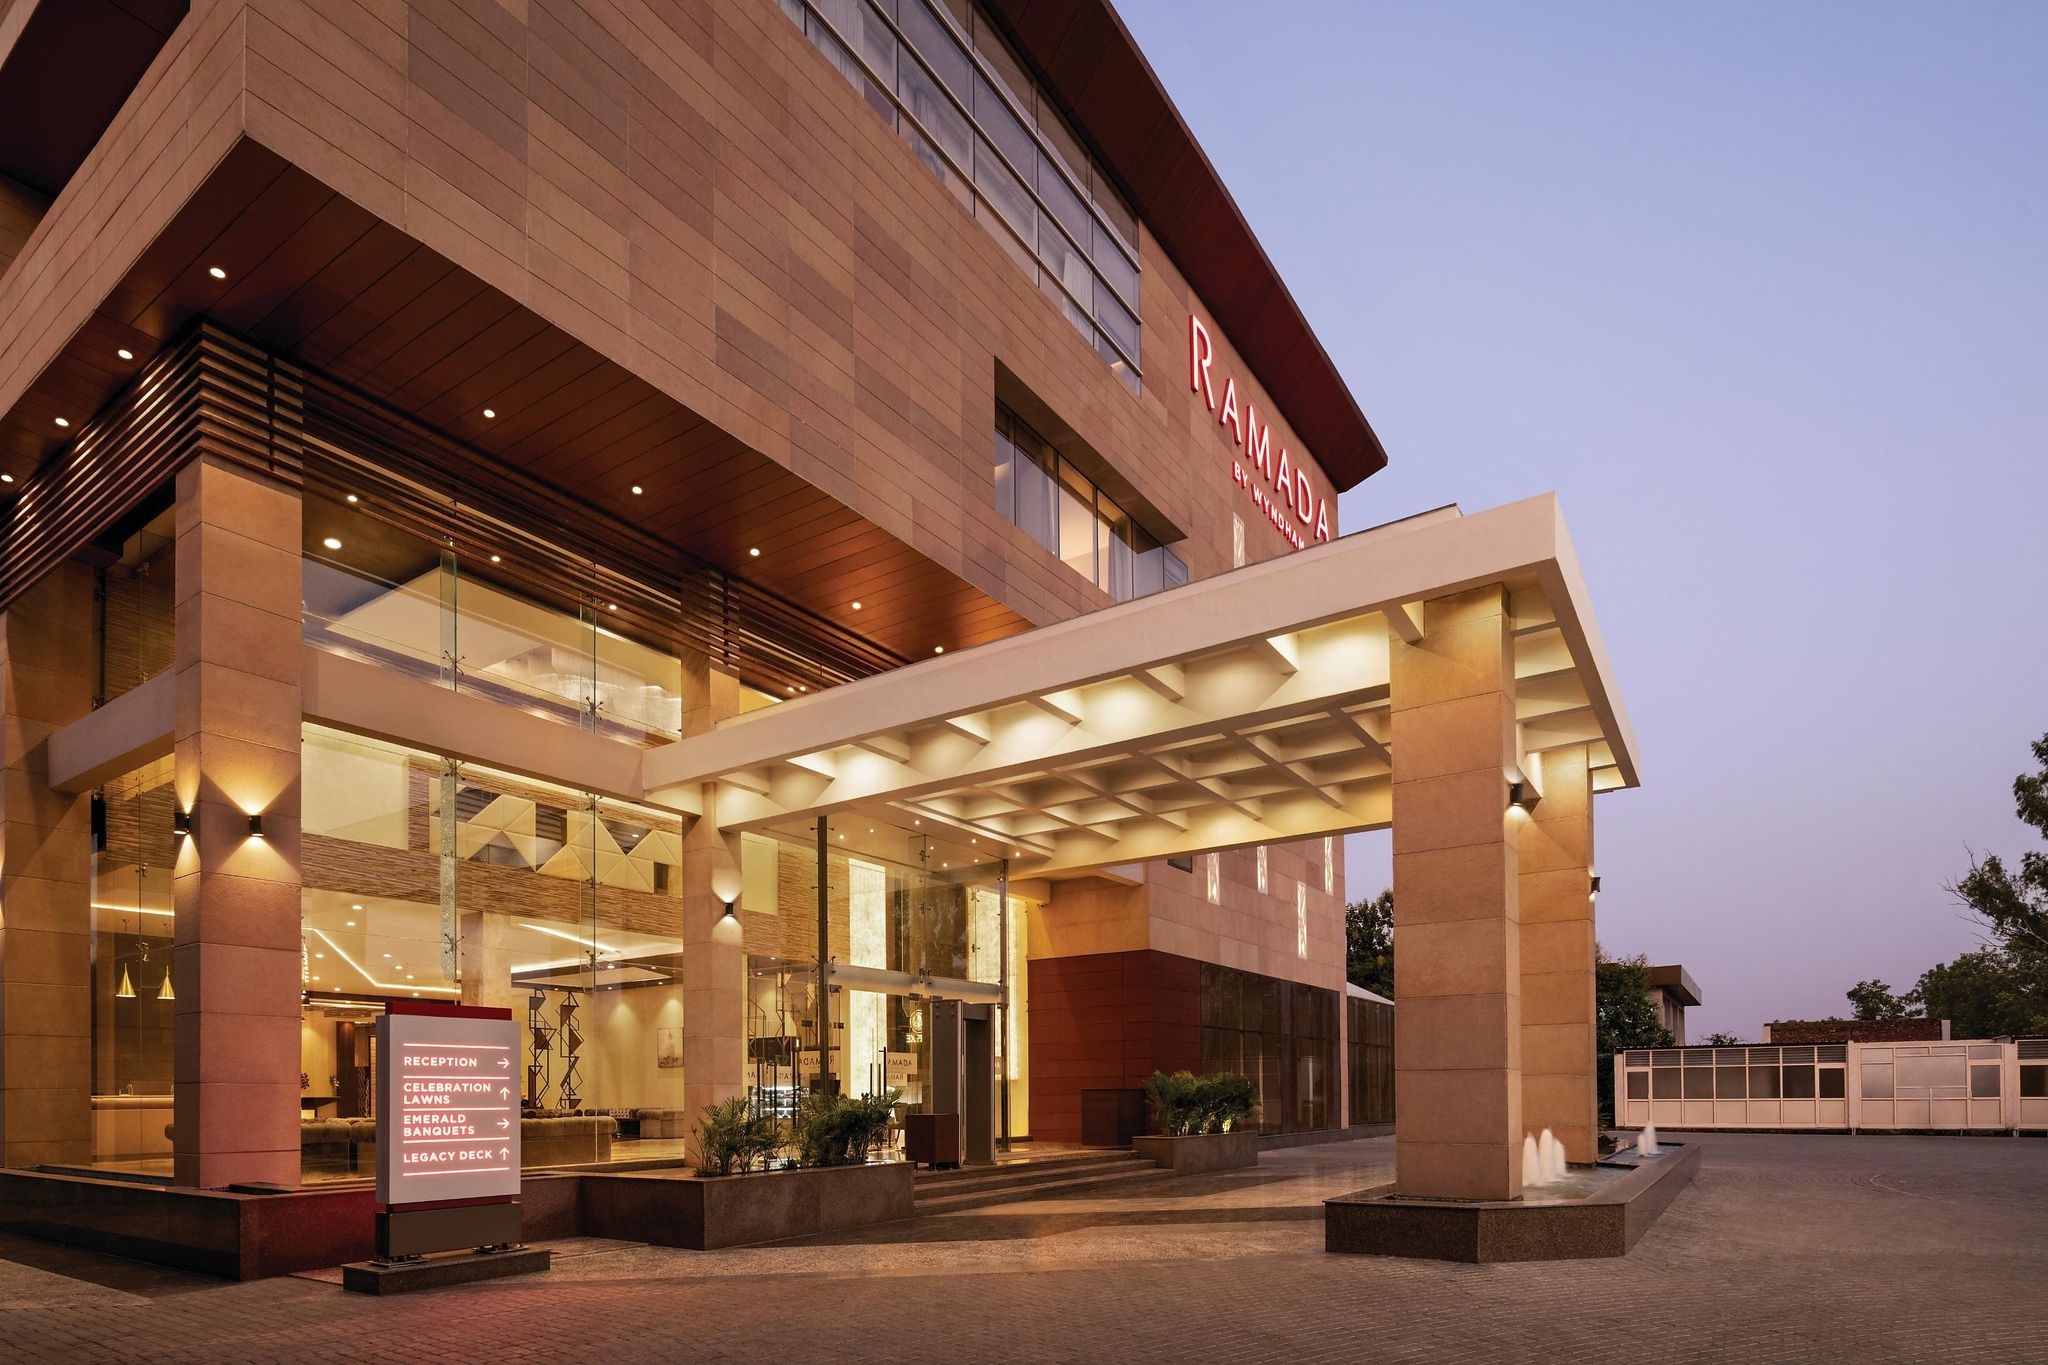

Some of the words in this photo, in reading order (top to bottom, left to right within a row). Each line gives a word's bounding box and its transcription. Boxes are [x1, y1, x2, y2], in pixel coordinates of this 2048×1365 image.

[1189, 314, 1330, 541] RAMADA
[1232, 460, 1248, 489] BY
[1251, 483, 1305, 551] WYNDHAM
[403, 1056, 477, 1067] RECEPTION
[403, 1082, 491, 1093] CELEBRATION
[403, 1094, 451, 1105] LAWNS
[403, 1114, 466, 1125] EMERALD
[403, 1126, 475, 1137] BANQUETS
[403, 1152, 456, 1163] LEGACY
[459, 1150, 493, 1161] DECK
